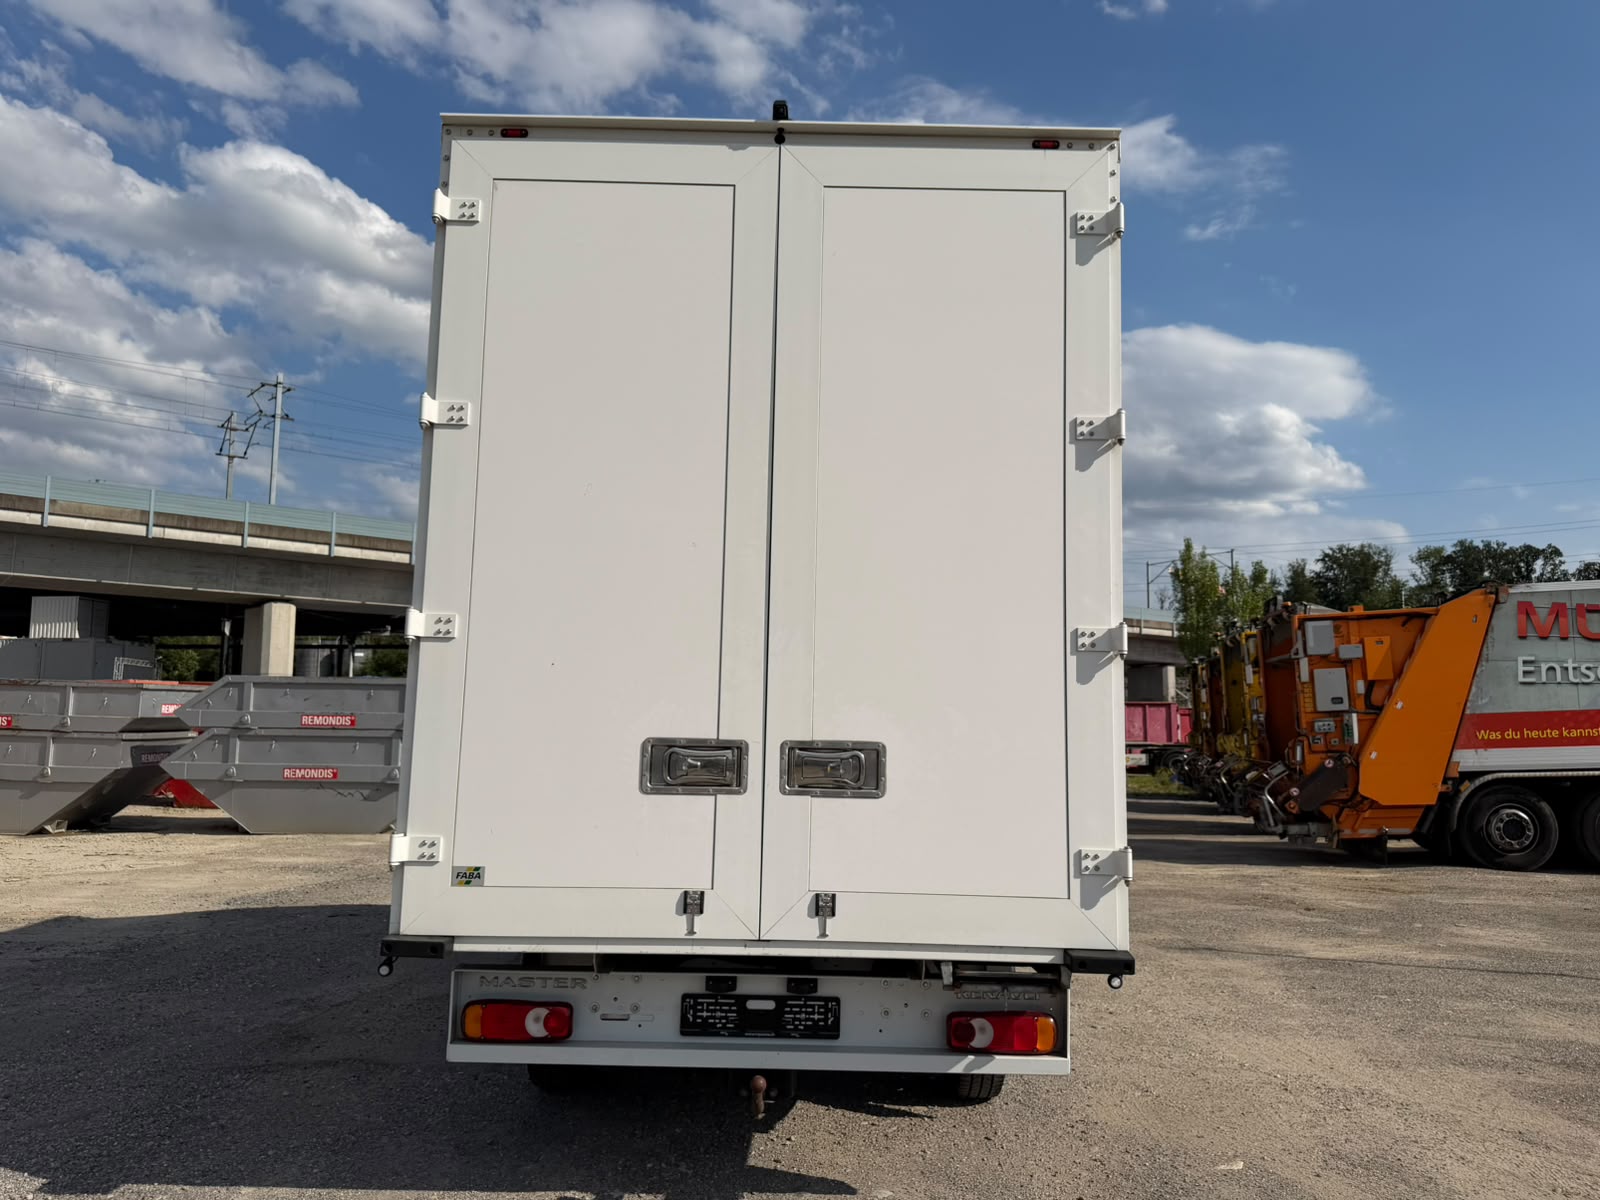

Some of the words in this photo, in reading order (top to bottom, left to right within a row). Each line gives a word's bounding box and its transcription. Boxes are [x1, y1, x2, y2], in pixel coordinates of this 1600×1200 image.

[1517, 656, 1600, 684] Ents
[301, 715, 352, 726] REMONDIS
[1476, 729, 1502, 740] Was
[1504, 728, 1520, 739] du
[1523, 728, 1559, 739] heute
[283, 768, 334, 779] REMONDIS
[455, 871, 482, 880] FABA
[479, 975, 588, 990] MASTER
